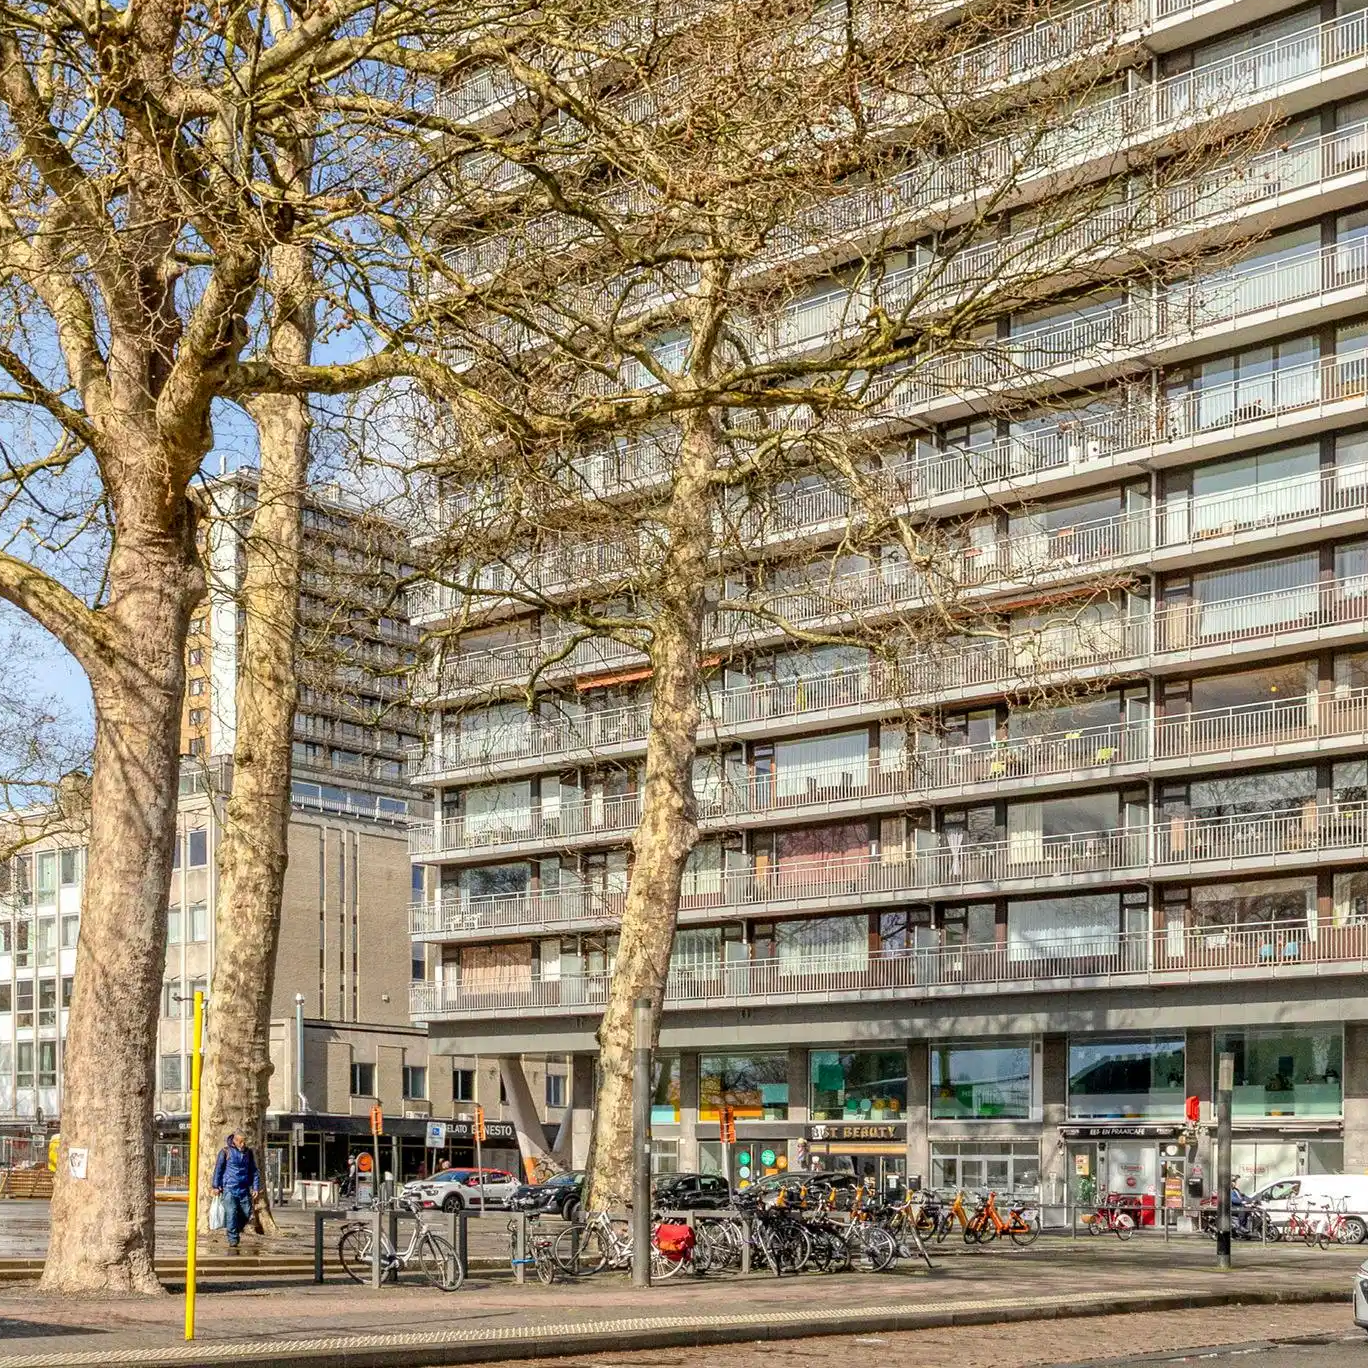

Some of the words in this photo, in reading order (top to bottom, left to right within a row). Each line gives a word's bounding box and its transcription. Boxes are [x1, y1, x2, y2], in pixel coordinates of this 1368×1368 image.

[447, 1124, 468, 1134] ELATO
[471, 1125, 512, 1136] ENESTO
[843, 1125, 897, 1139] BEAUTY
